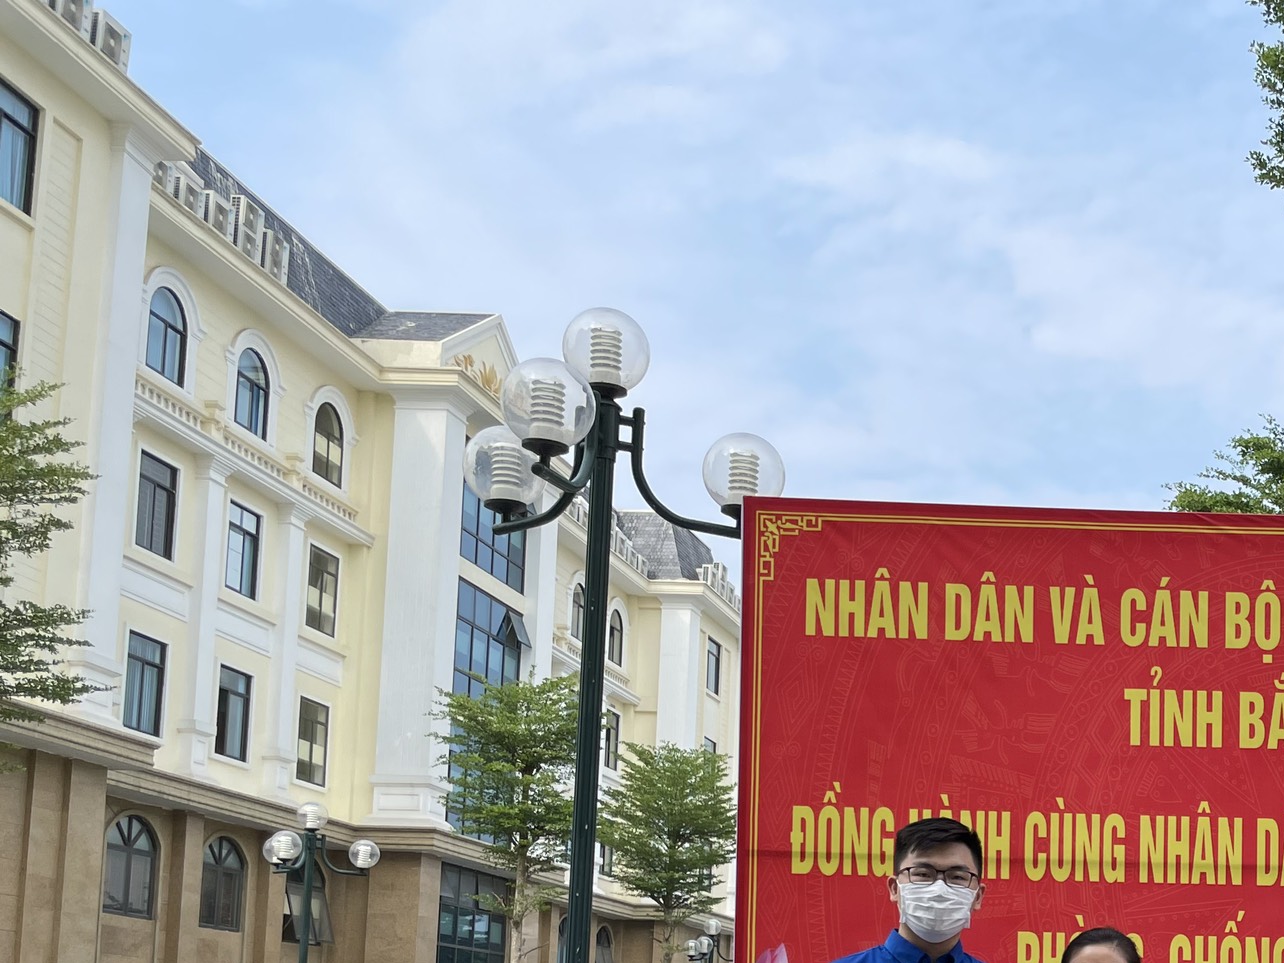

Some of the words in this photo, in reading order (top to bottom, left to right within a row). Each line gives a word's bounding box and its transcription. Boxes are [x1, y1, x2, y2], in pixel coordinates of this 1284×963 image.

[805, 567, 929, 639] NHÂN
[945, 571, 1034, 643] DÂN
[1050, 574, 1105, 645] VÀ
[1120, 576, 1209, 648] CÁN
[1225, 578, 1281, 663] BỘ
[1124, 665, 1223, 748] TỈNH
[790, 781, 895, 877] ĐỒNG
[1024, 797, 1125, 883] CÙNG
[1139, 800, 1243, 885] NHÂN
